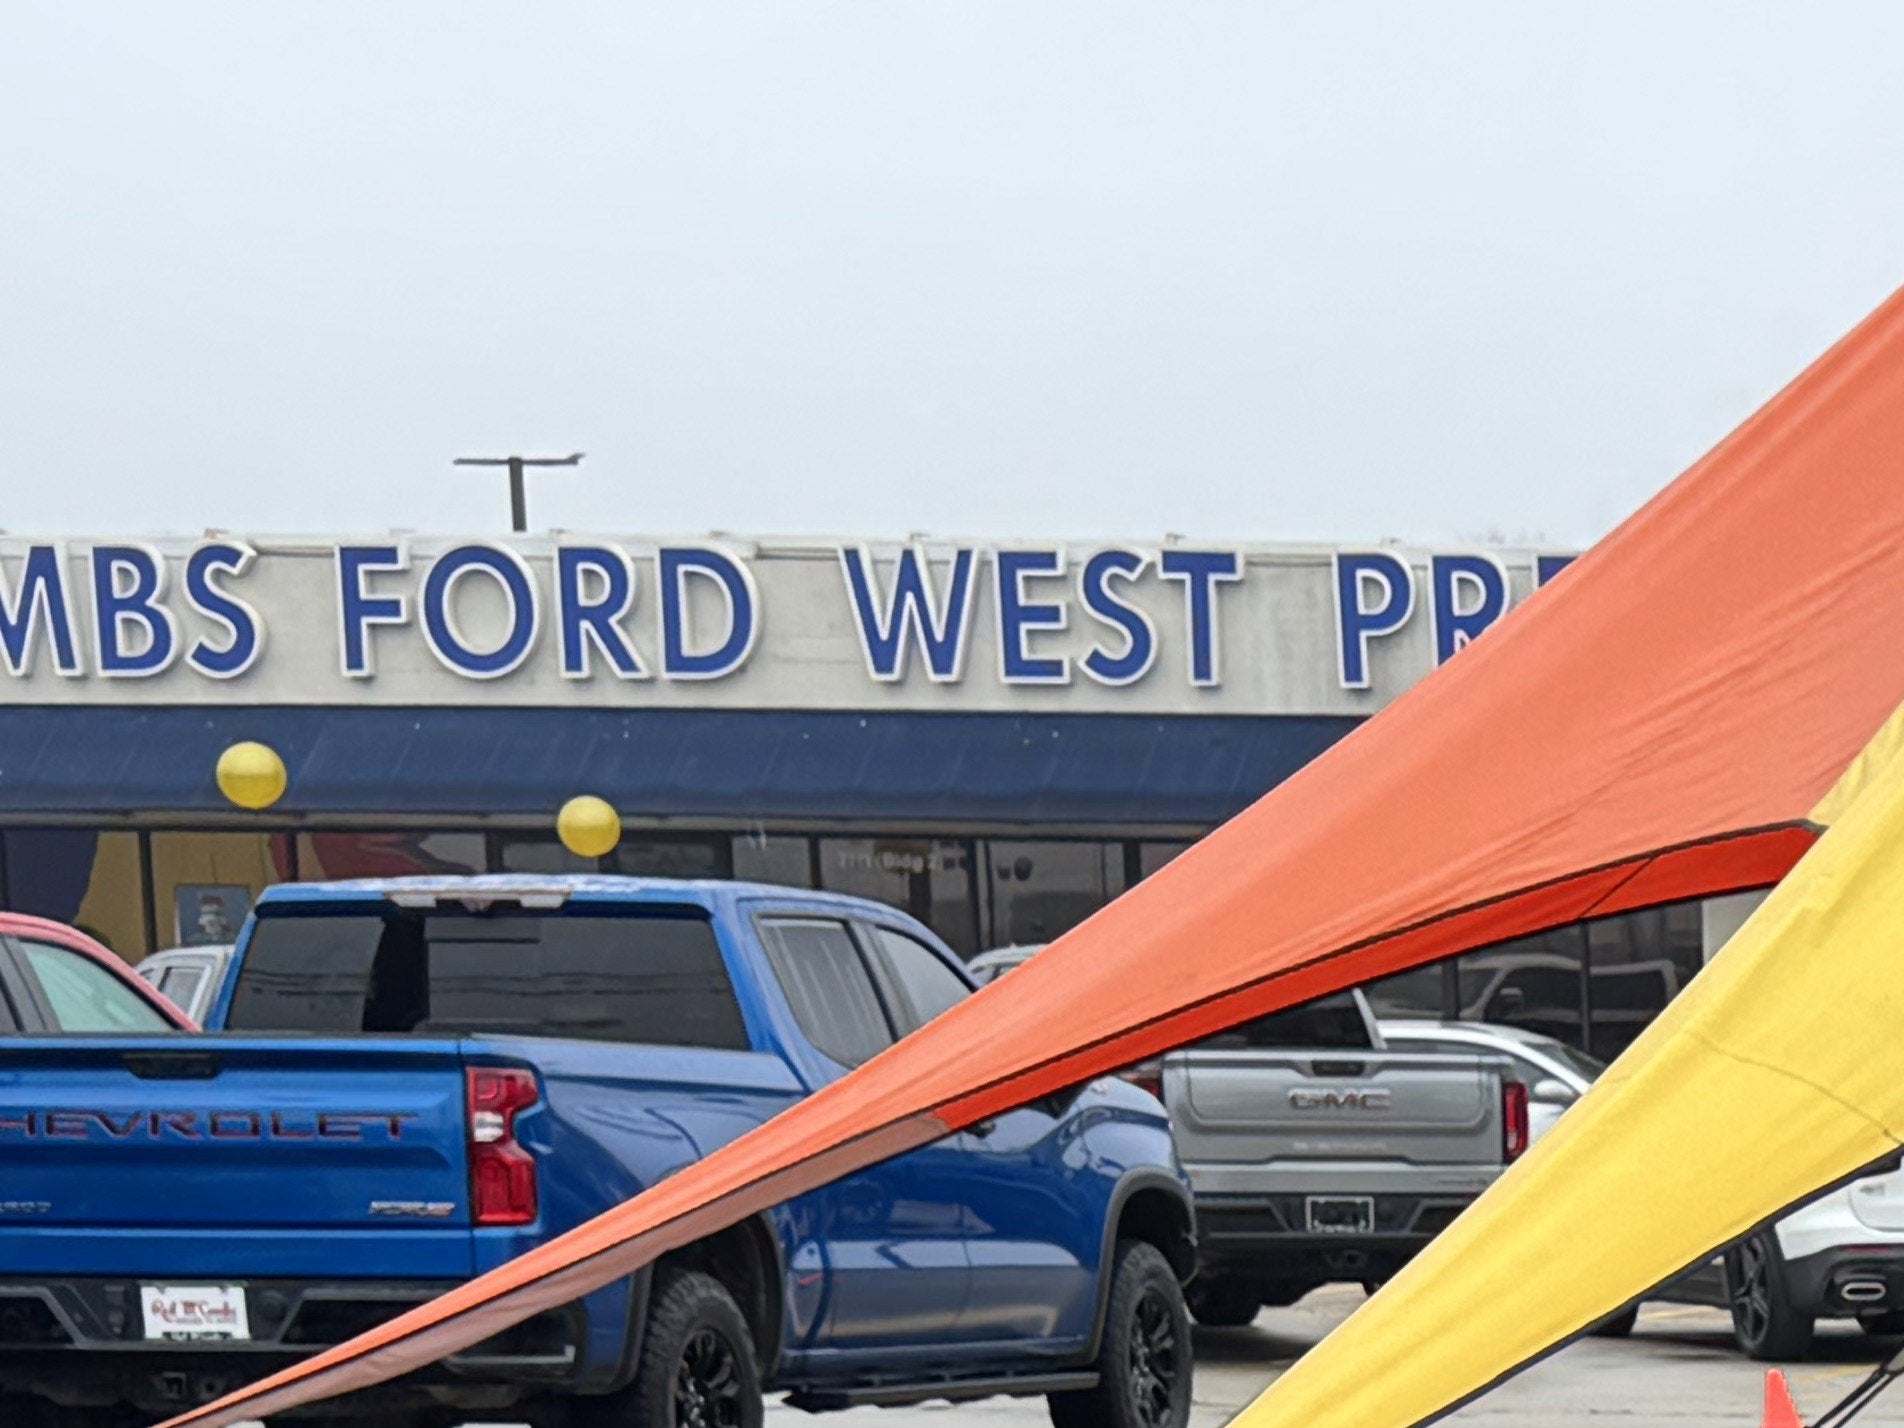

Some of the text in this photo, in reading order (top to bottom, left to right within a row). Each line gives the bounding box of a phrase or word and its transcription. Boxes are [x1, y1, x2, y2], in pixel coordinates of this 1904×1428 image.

[336, 542, 760, 681] FORD
[838, 546, 1242, 688] WEST
[1333, 550, 1583, 689] PR
[1287, 1088, 1391, 1110] GMC
